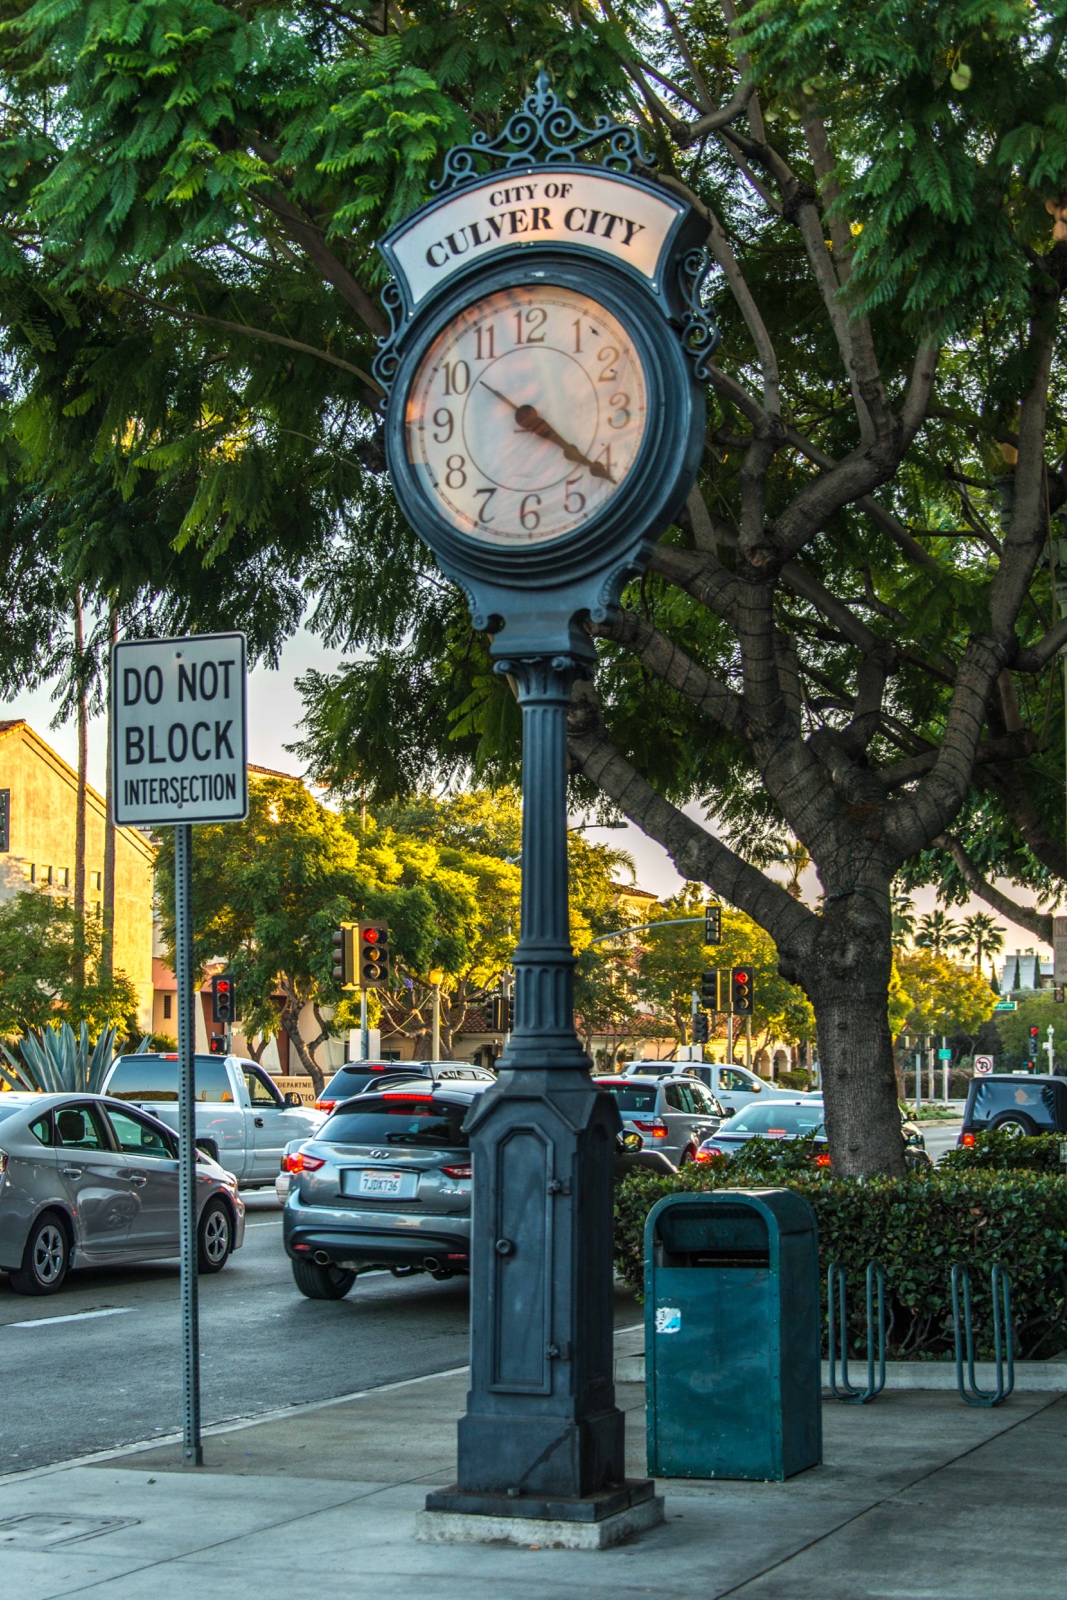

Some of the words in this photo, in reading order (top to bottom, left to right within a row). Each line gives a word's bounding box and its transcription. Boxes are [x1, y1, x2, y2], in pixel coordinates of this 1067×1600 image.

[490, 184, 538, 207] CITY
[544, 183, 573, 199] OF
[426, 206, 553, 268] CULVER
[564, 207, 645, 247] CITY
[474, 324, 496, 360] 11
[513, 308, 548, 345] 12
[571, 319, 584, 354] 1
[441, 360, 471, 396] 10
[597, 346, 620, 383] 2
[433, 408, 454, 443] 9
[607, 392, 631, 429] 3
[445, 455, 467, 489] 8
[594, 443, 618, 480] 4
[472, 487, 498, 524] 7
[519, 494, 542, 531] 6
[563, 474, 587, 514] 5
[123, 664, 164, 706] DO
[178, 660, 235, 702] NOT
[125, 719, 235, 765] BLOCK
[124, 773, 236, 806] INTERSECTION
